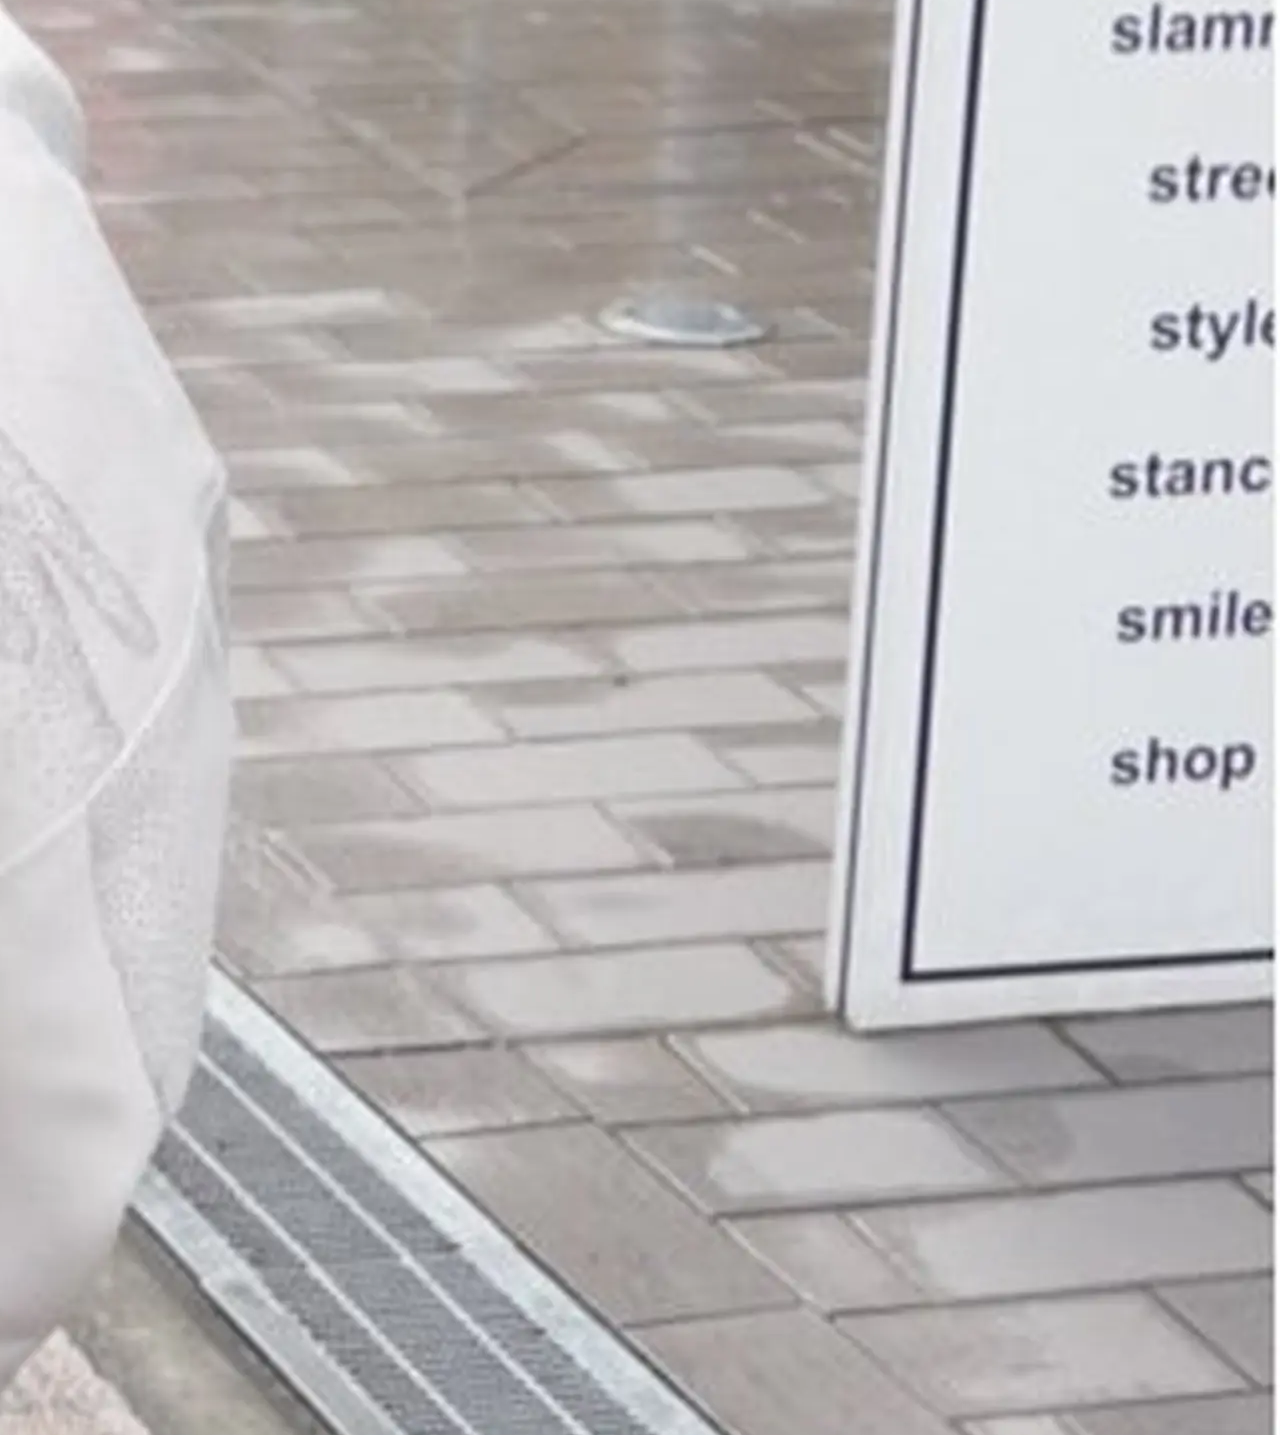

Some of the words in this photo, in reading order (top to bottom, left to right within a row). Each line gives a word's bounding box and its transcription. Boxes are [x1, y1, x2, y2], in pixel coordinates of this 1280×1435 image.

[1146, 153, 1275, 204] stre
[1107, 451, 1273, 499] stanc
[1115, 590, 1274, 643] smile
[1109, 736, 1257, 791] shop
